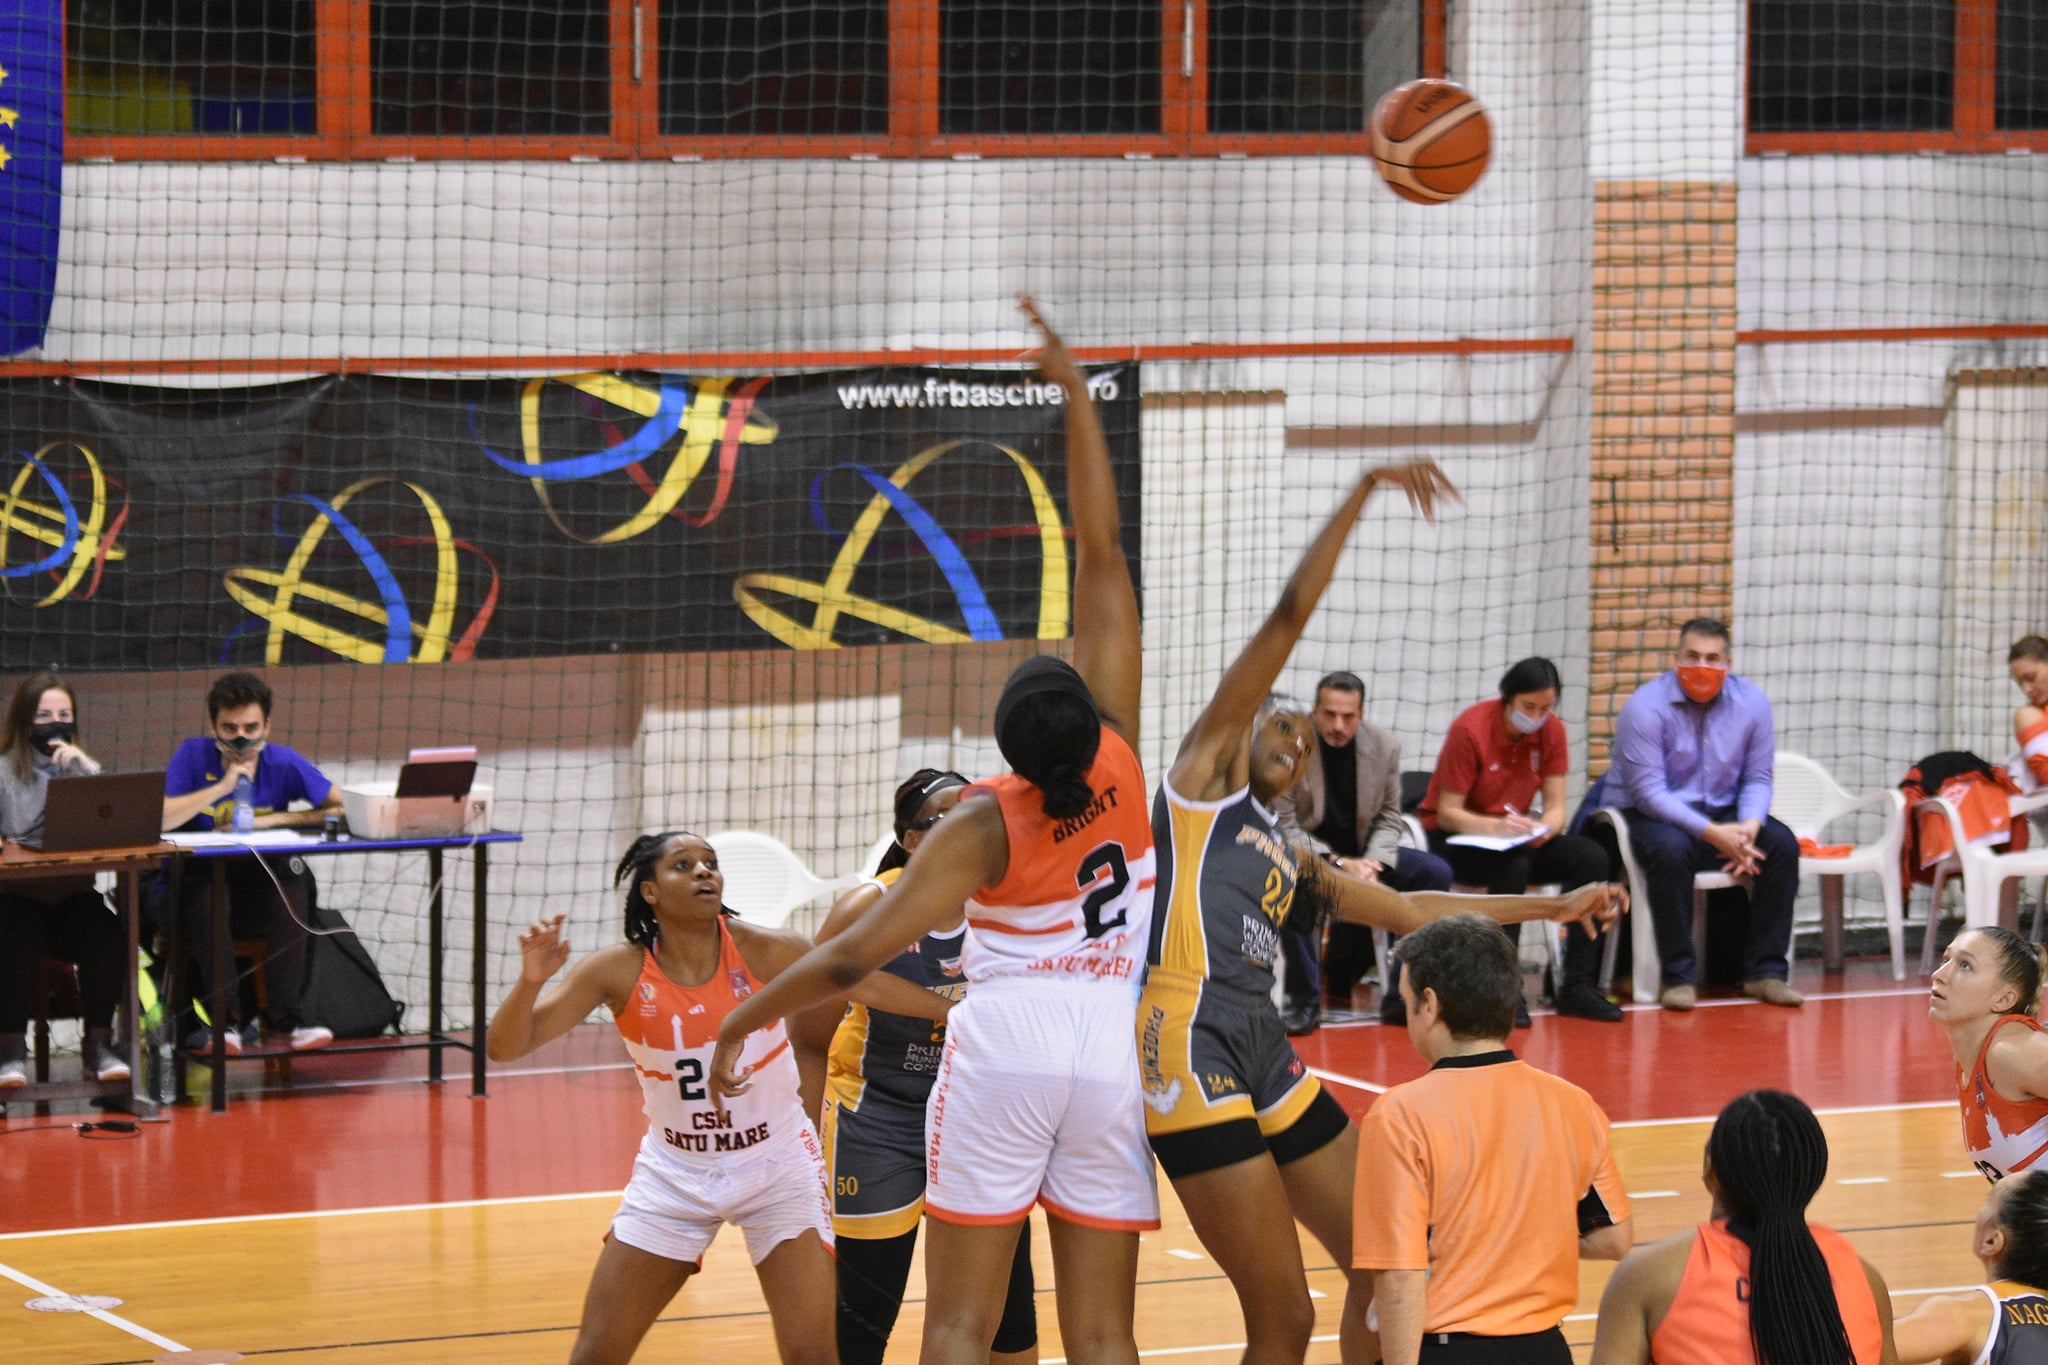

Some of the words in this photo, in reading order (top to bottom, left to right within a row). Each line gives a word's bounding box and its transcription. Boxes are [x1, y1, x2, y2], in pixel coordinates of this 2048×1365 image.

[837, 378, 1120, 409] www.frbaschero
[1053, 786, 1118, 844] BRIGHT
[1075, 840, 1130, 942] 2
[1261, 867, 1295, 929] 24
[675, 1058, 706, 1100] 2
[692, 1110, 733, 1130] CSM
[664, 1127, 708, 1152] SATU
[714, 1122, 770, 1152] MARE
[836, 1176, 859, 1196] 50
[2004, 1303, 2048, 1327] NAG
